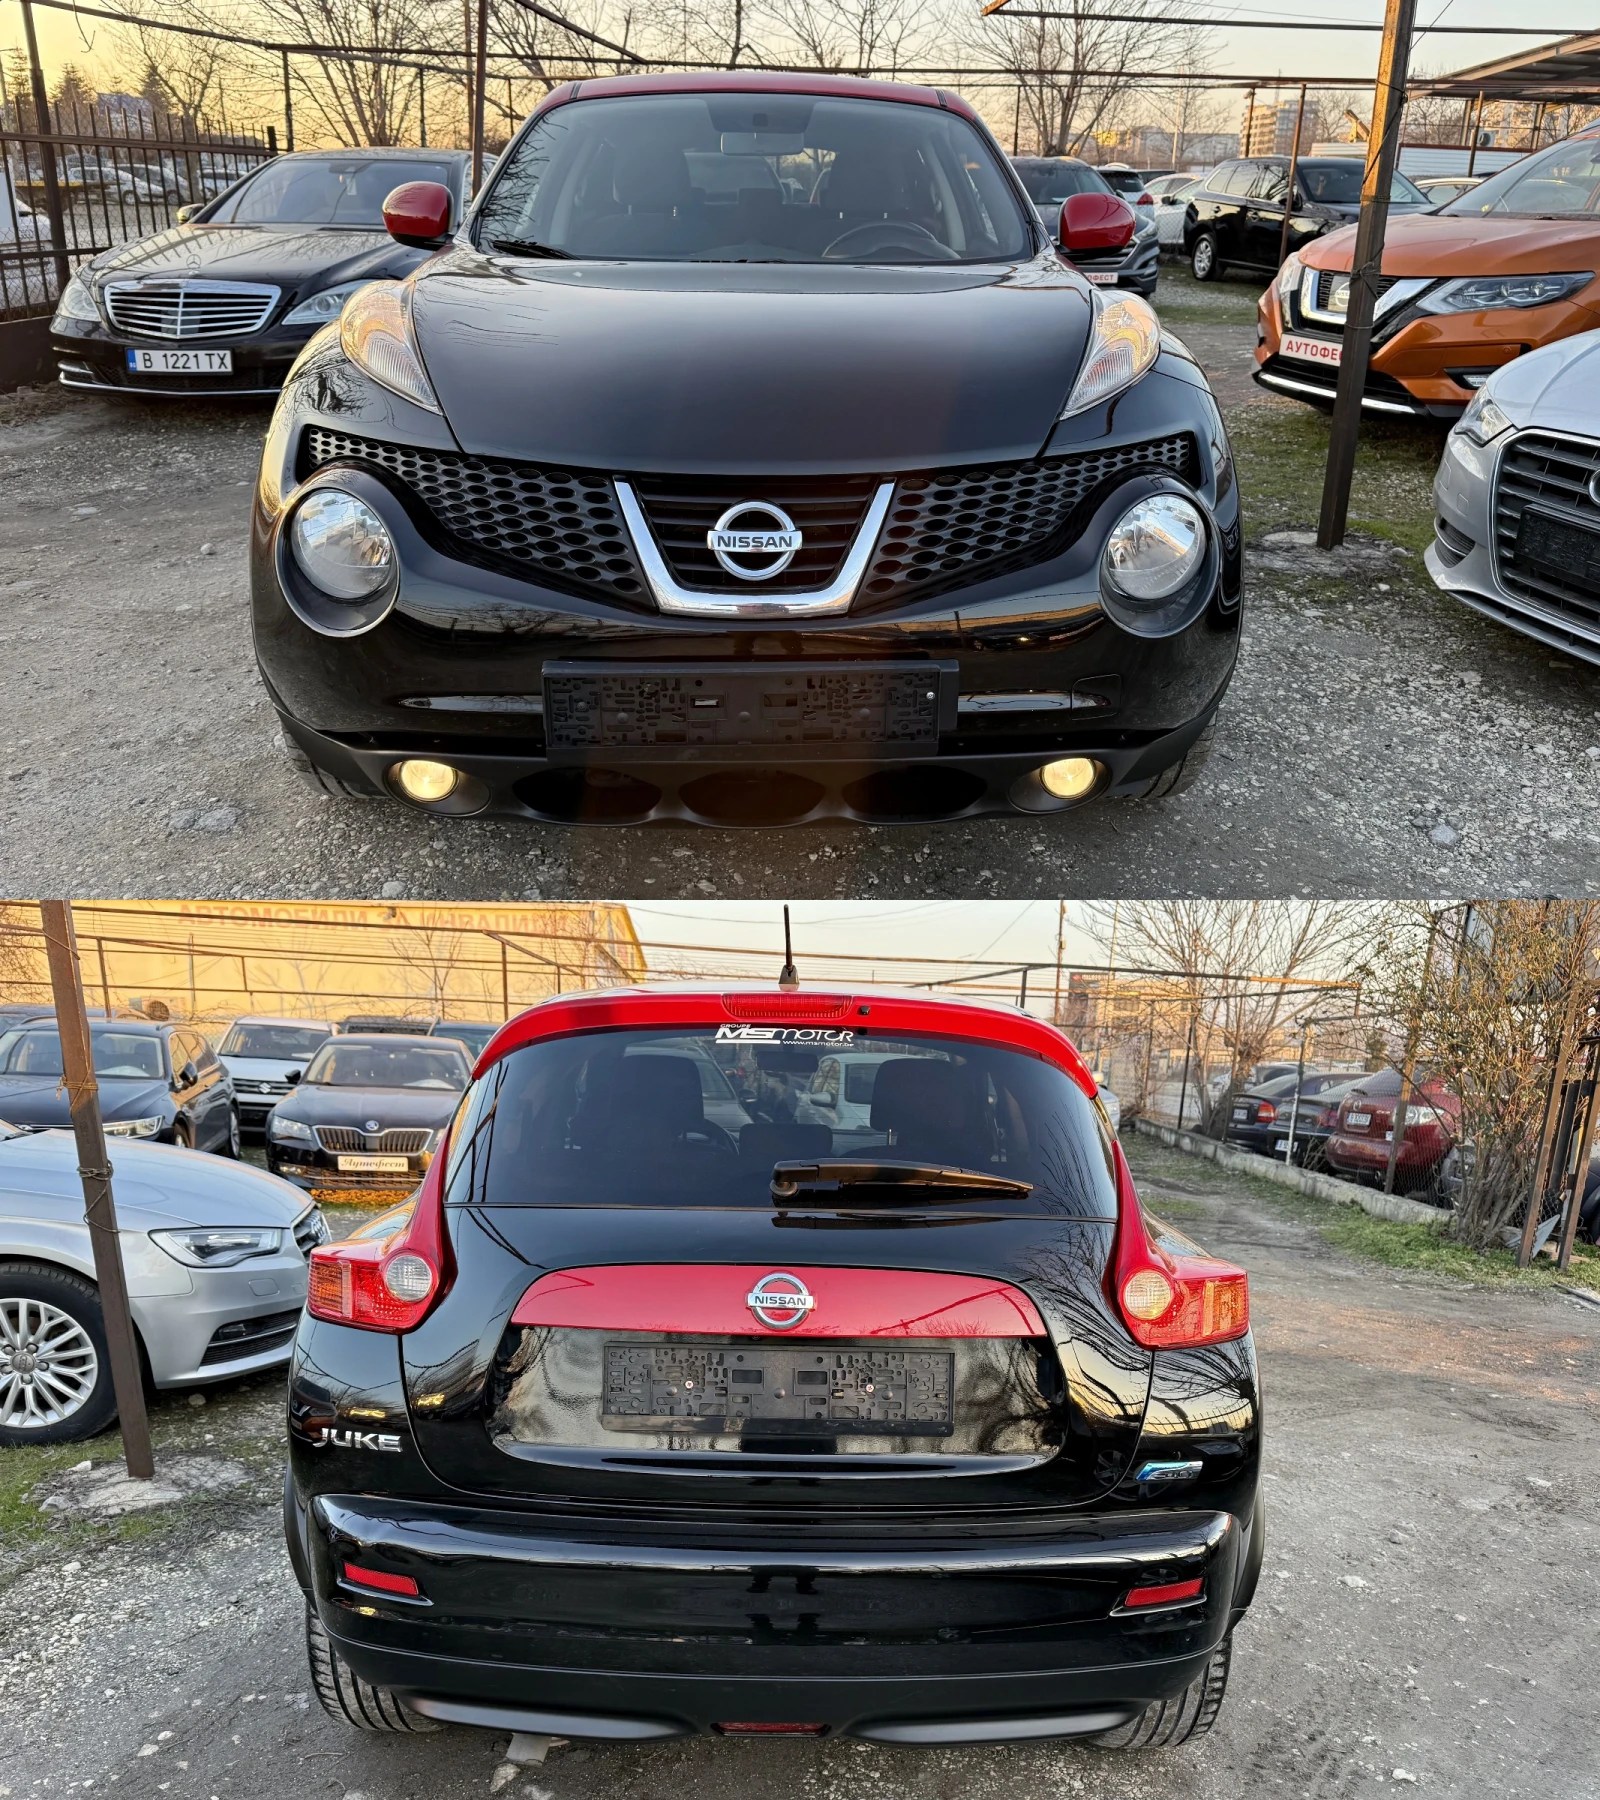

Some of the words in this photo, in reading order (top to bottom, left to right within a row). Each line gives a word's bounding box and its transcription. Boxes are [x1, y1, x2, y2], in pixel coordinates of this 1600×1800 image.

[142, 352, 153, 369] B
[717, 535, 792, 549] NISSAN
[754, 1295, 806, 1306] NISSAN
[312, 1427, 403, 1452] JUKE
